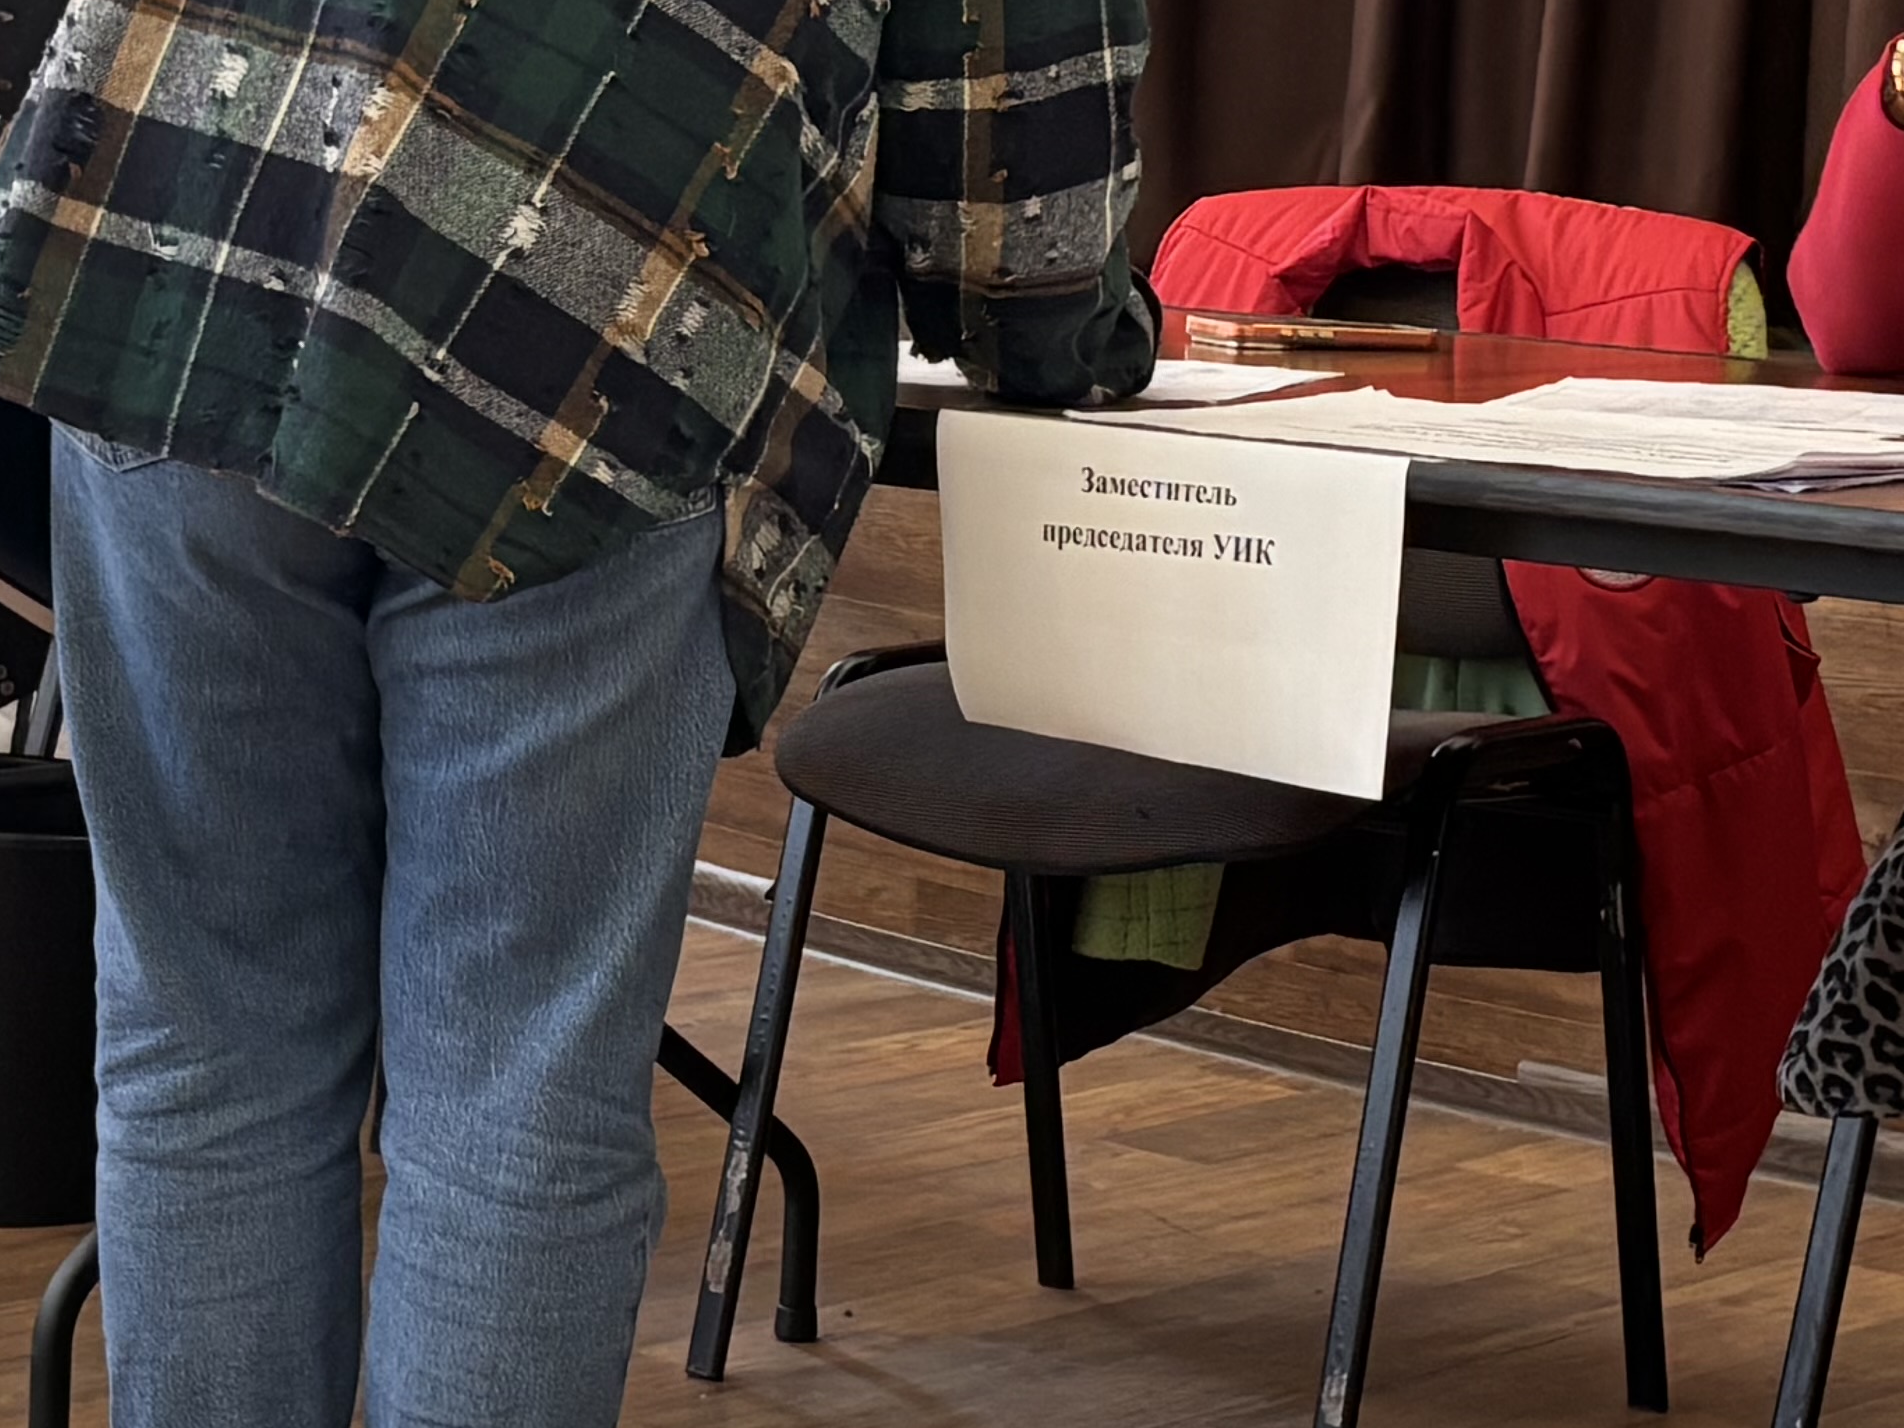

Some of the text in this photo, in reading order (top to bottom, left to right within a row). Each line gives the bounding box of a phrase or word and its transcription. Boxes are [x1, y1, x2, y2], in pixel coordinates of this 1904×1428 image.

[1081, 465, 1238, 507] Заместитель
[1042, 523, 1276, 567] председателя УИК
